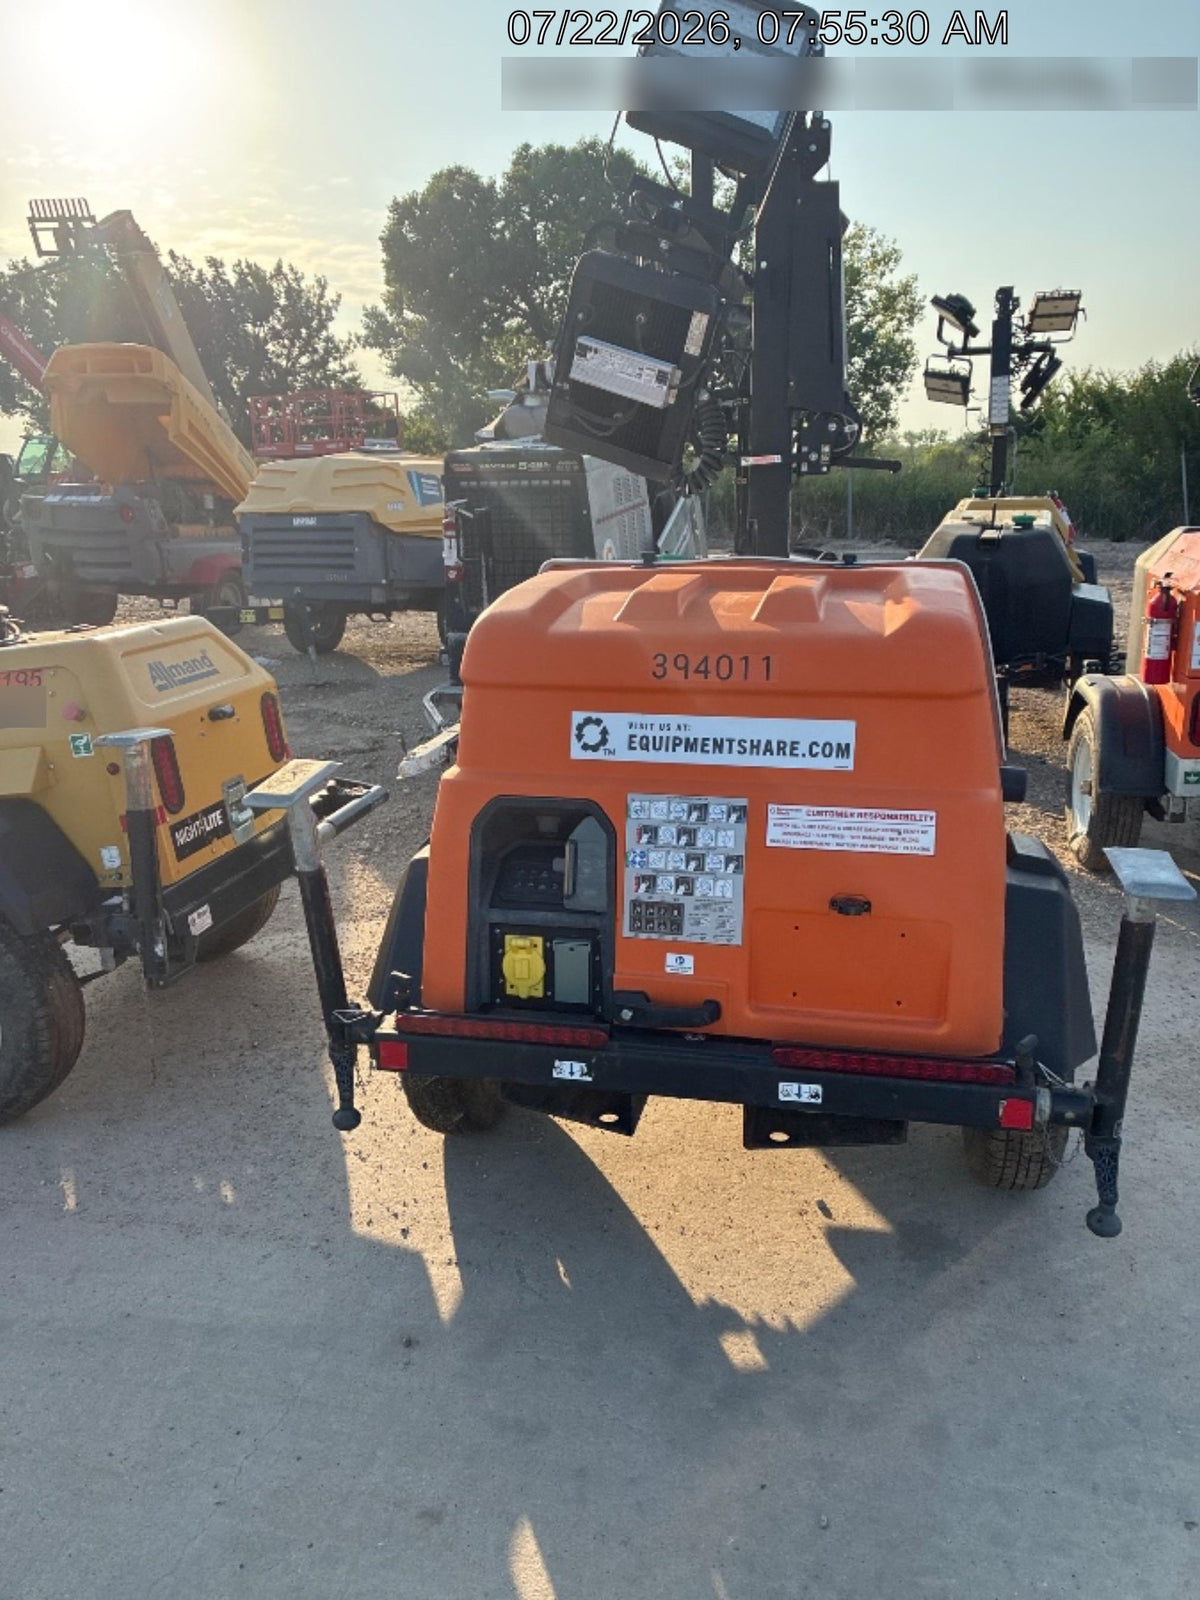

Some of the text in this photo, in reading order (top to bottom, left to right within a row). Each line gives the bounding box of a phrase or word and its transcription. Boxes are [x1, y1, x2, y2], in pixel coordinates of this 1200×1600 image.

[147, 649, 214, 688] Allmand
[652, 653, 772, 681] 394011
[627, 721, 692, 732] VISIT US AT:
[627, 734, 851, 760] EQUIPMENTSHARE.COM
